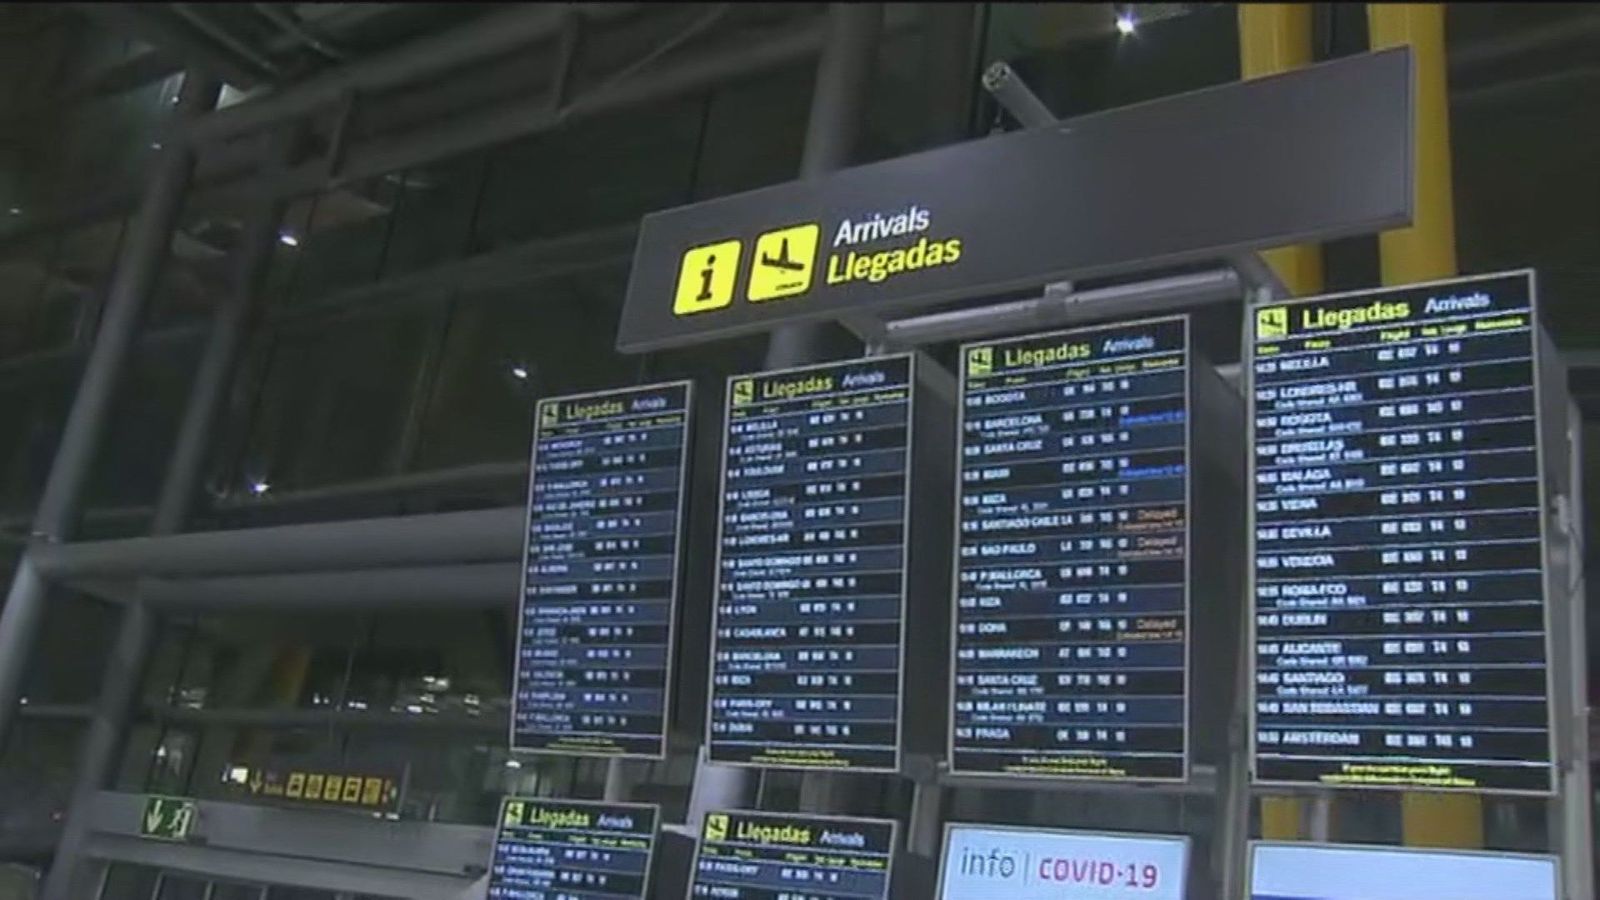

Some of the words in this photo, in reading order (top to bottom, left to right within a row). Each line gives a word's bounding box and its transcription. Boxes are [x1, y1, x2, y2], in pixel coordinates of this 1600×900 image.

[833, 205, 930, 247] Arrivals
[827, 236, 961, 285] Llegadas
[1303, 301, 1411, 329] Llegadas
[1425, 292, 1490, 314] Arrivals
[1005, 343, 1091, 367] Llegadas
[1103, 336, 1155, 353] Arrivals
[763, 376, 833, 398] Llegadas
[566, 400, 624, 420] Llegadas
[530, 807, 590, 828] Llegadas
[737, 820, 811, 845] Llegadas
[961, 846, 1015, 878] info
